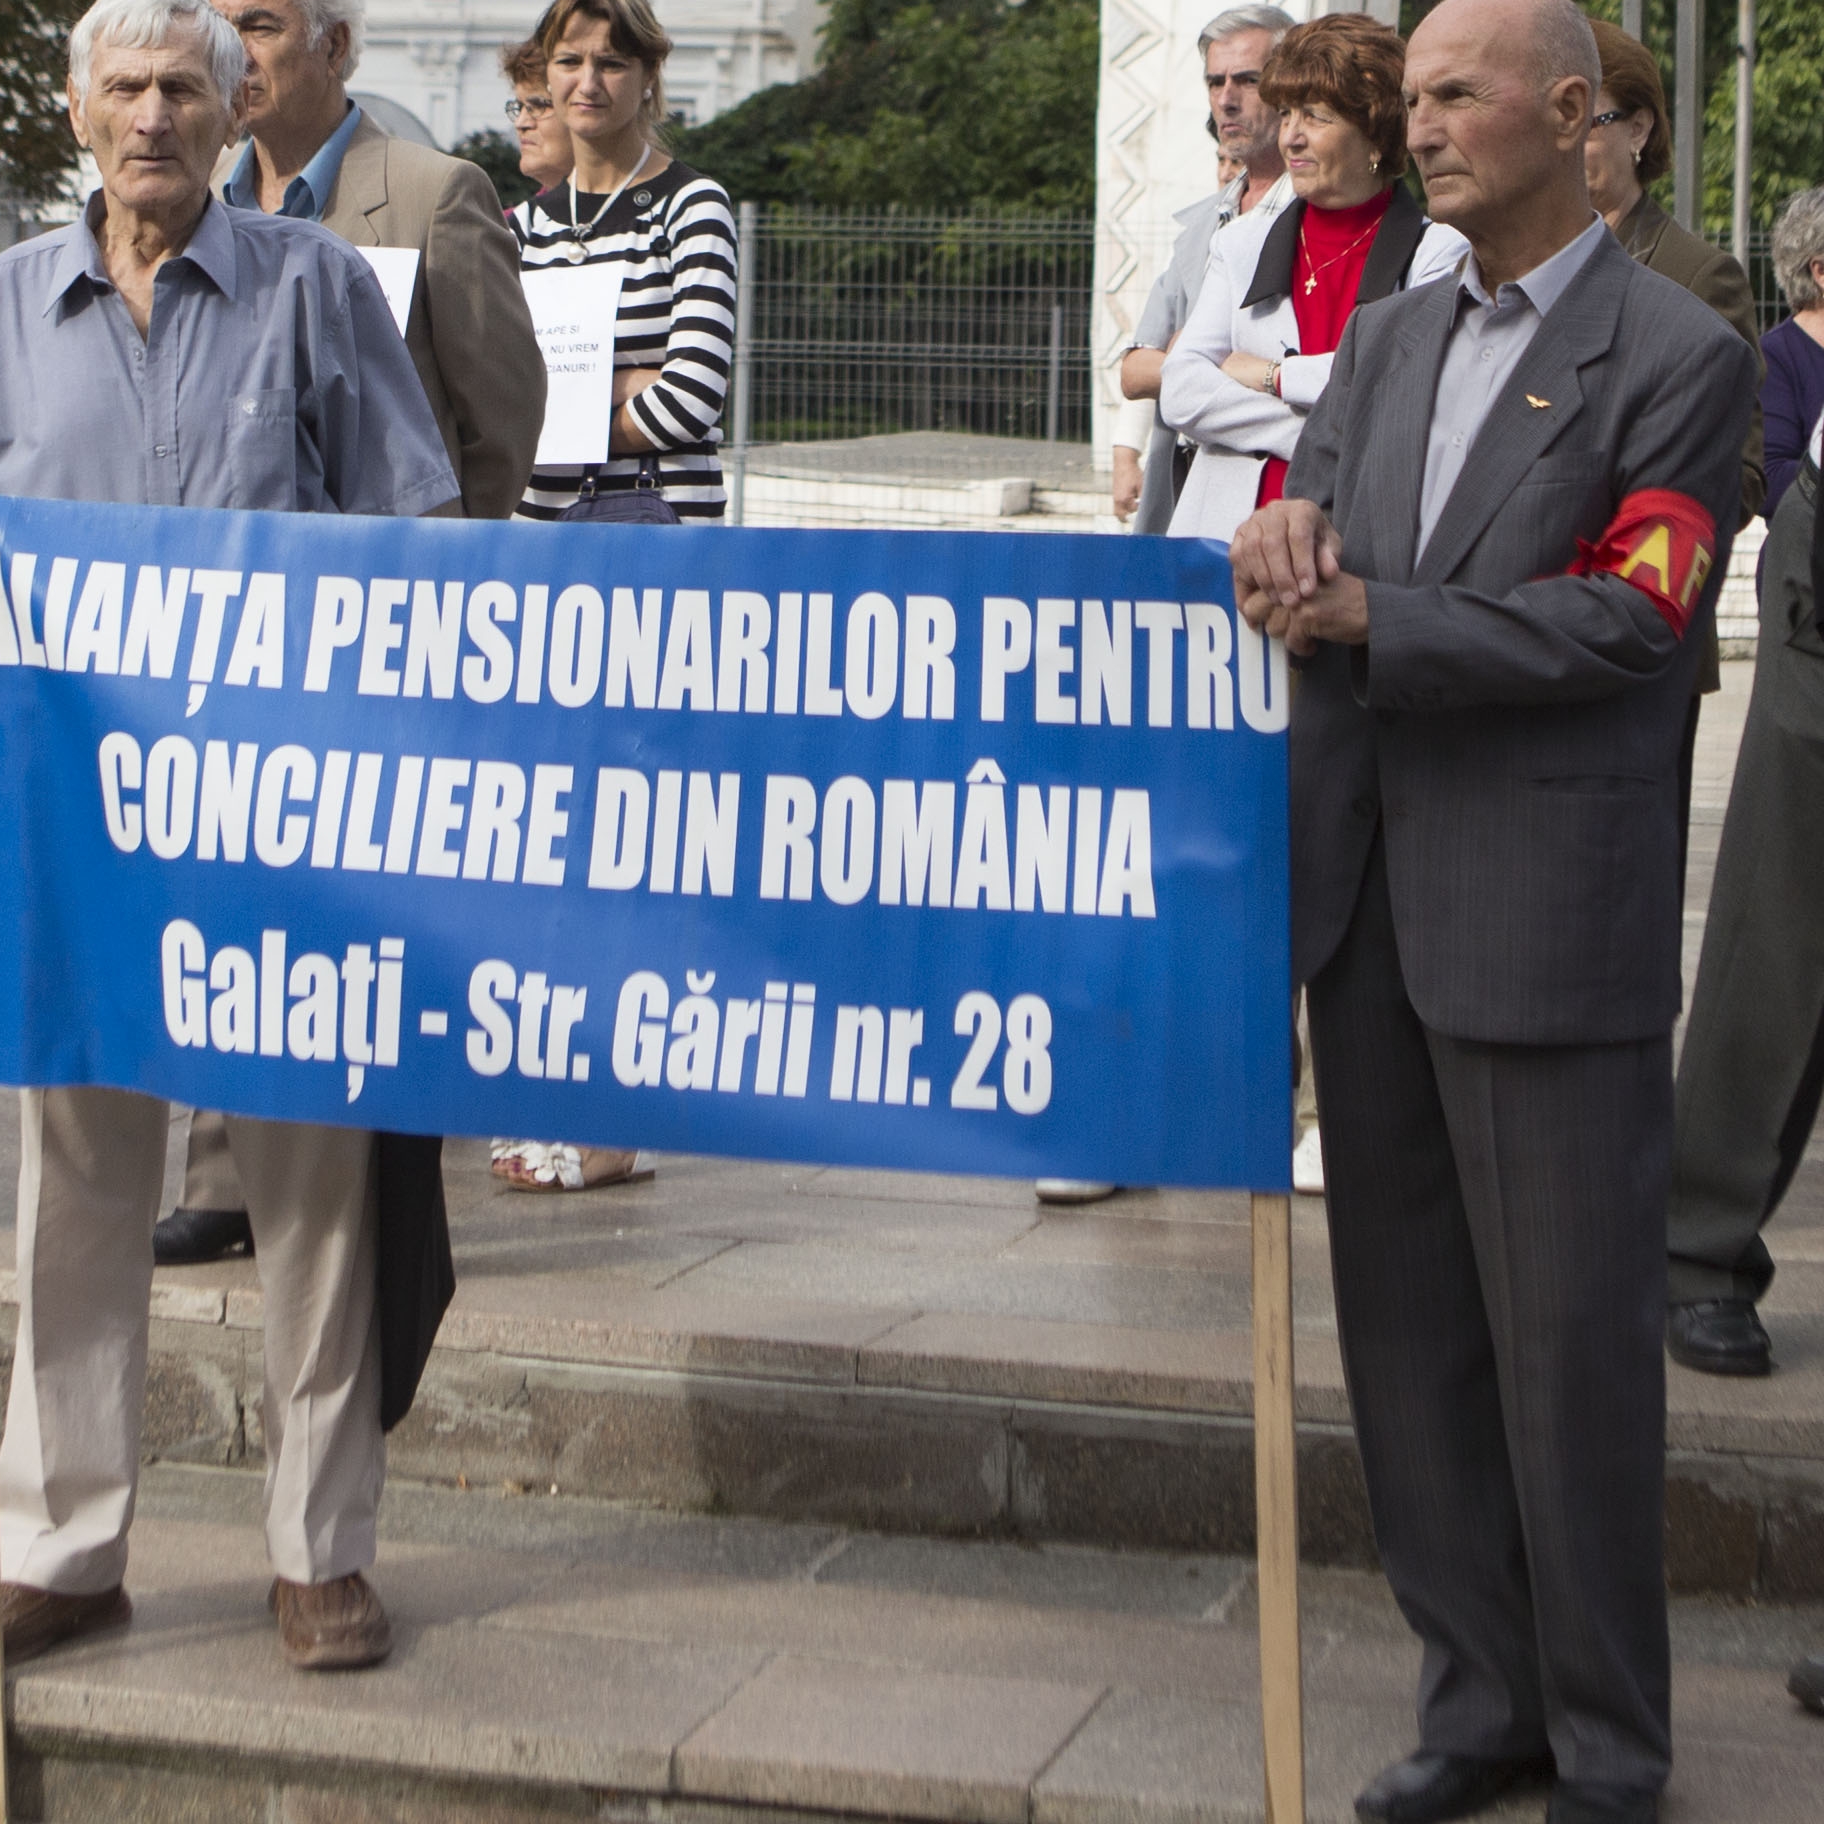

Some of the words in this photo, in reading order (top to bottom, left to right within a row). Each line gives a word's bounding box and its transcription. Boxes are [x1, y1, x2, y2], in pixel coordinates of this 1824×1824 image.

[568, 343, 599, 353] VREM
[303, 575, 957, 720] PENSIONARILOR
[980, 597, 1290, 734] PENTRU
[98, 731, 574, 886] CONCILIERE
[588, 766, 741, 897] DIN
[760, 758, 1157, 918] ROMÂNIA
[161, 919, 404, 1103] Galați
[466, 959, 590, 1081] Str.
[611, 969, 817, 1097] Gării
[829, 1005, 930, 1107] nr.
[951, 991, 1053, 1115] 28
